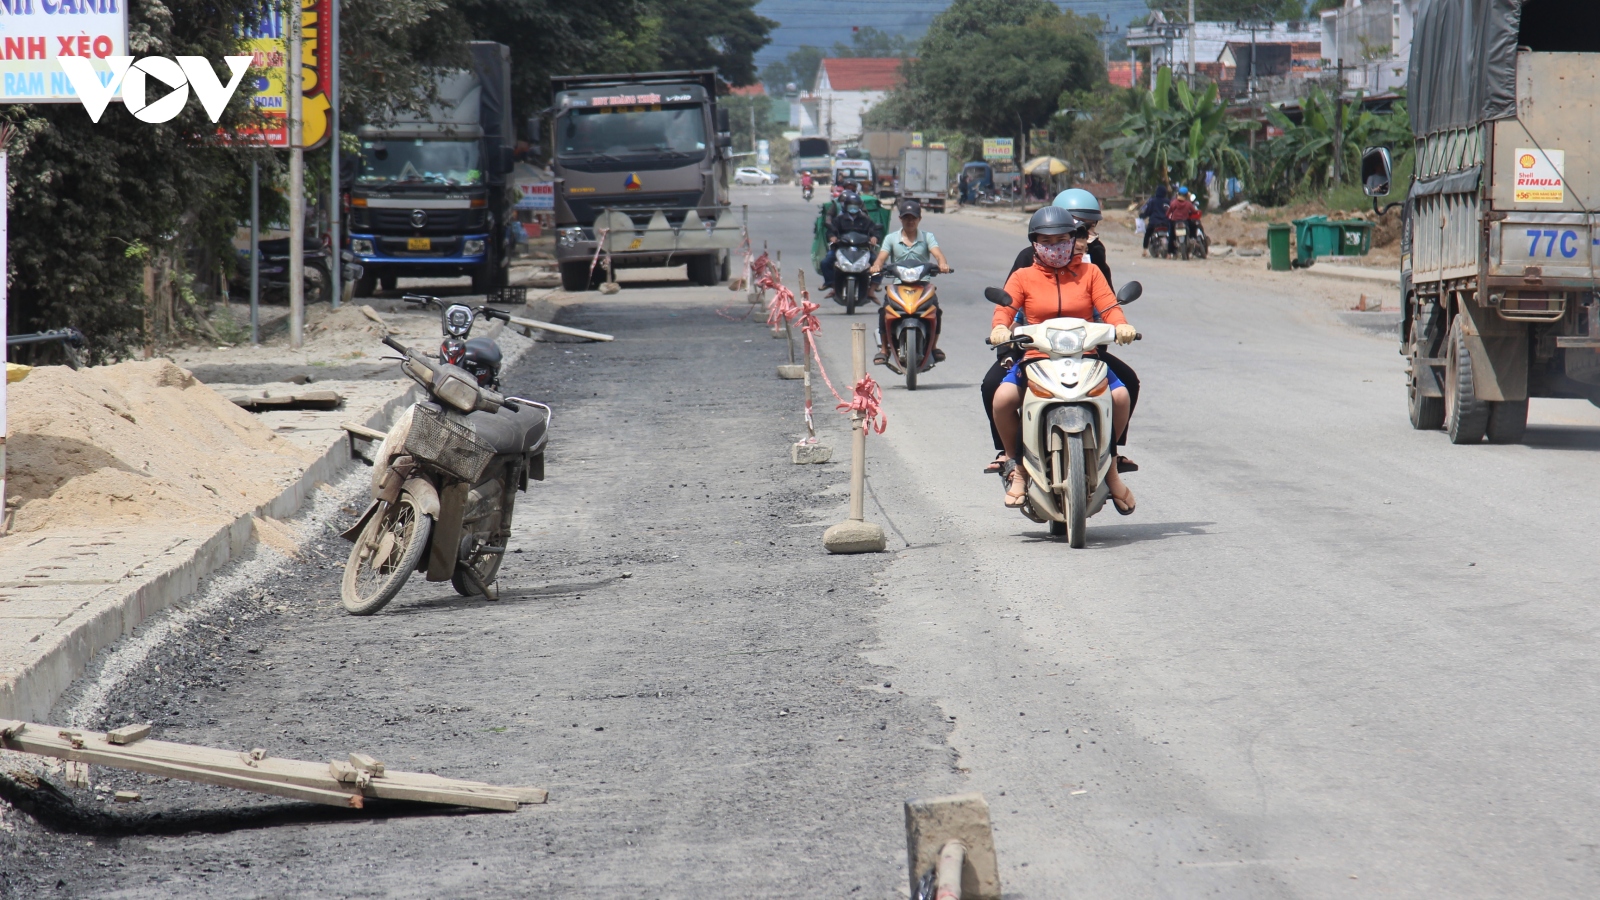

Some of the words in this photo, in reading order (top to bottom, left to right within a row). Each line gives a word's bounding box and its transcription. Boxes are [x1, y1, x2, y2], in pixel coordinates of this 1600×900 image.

[4, 72, 45, 96] RAM
[1517, 178, 1561, 186] RIMULA
[1526, 230, 1578, 258] 77C
